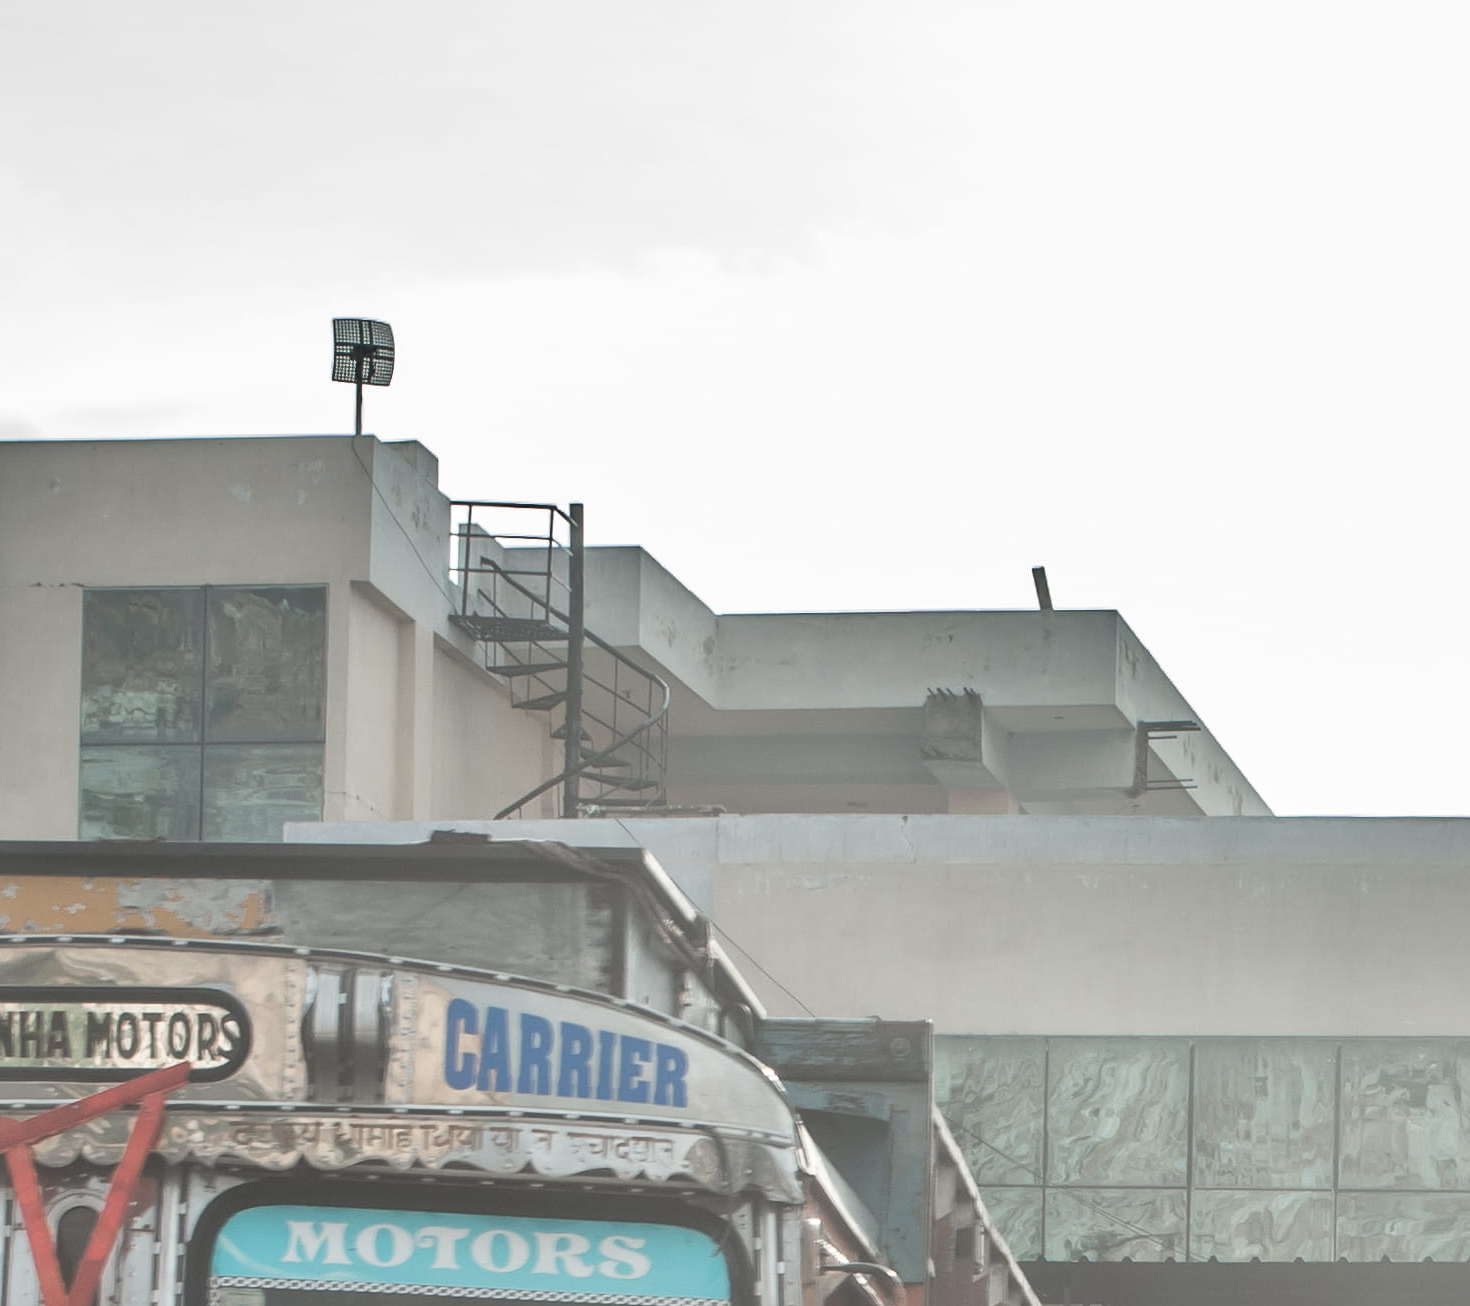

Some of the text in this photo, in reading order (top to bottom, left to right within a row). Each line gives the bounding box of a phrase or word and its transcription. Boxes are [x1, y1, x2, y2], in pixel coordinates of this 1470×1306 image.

[86, 1011, 243, 1061] MOTORS
[444, 998, 691, 1108] CARRIER
[281, 1220, 651, 1281] MOTORS
